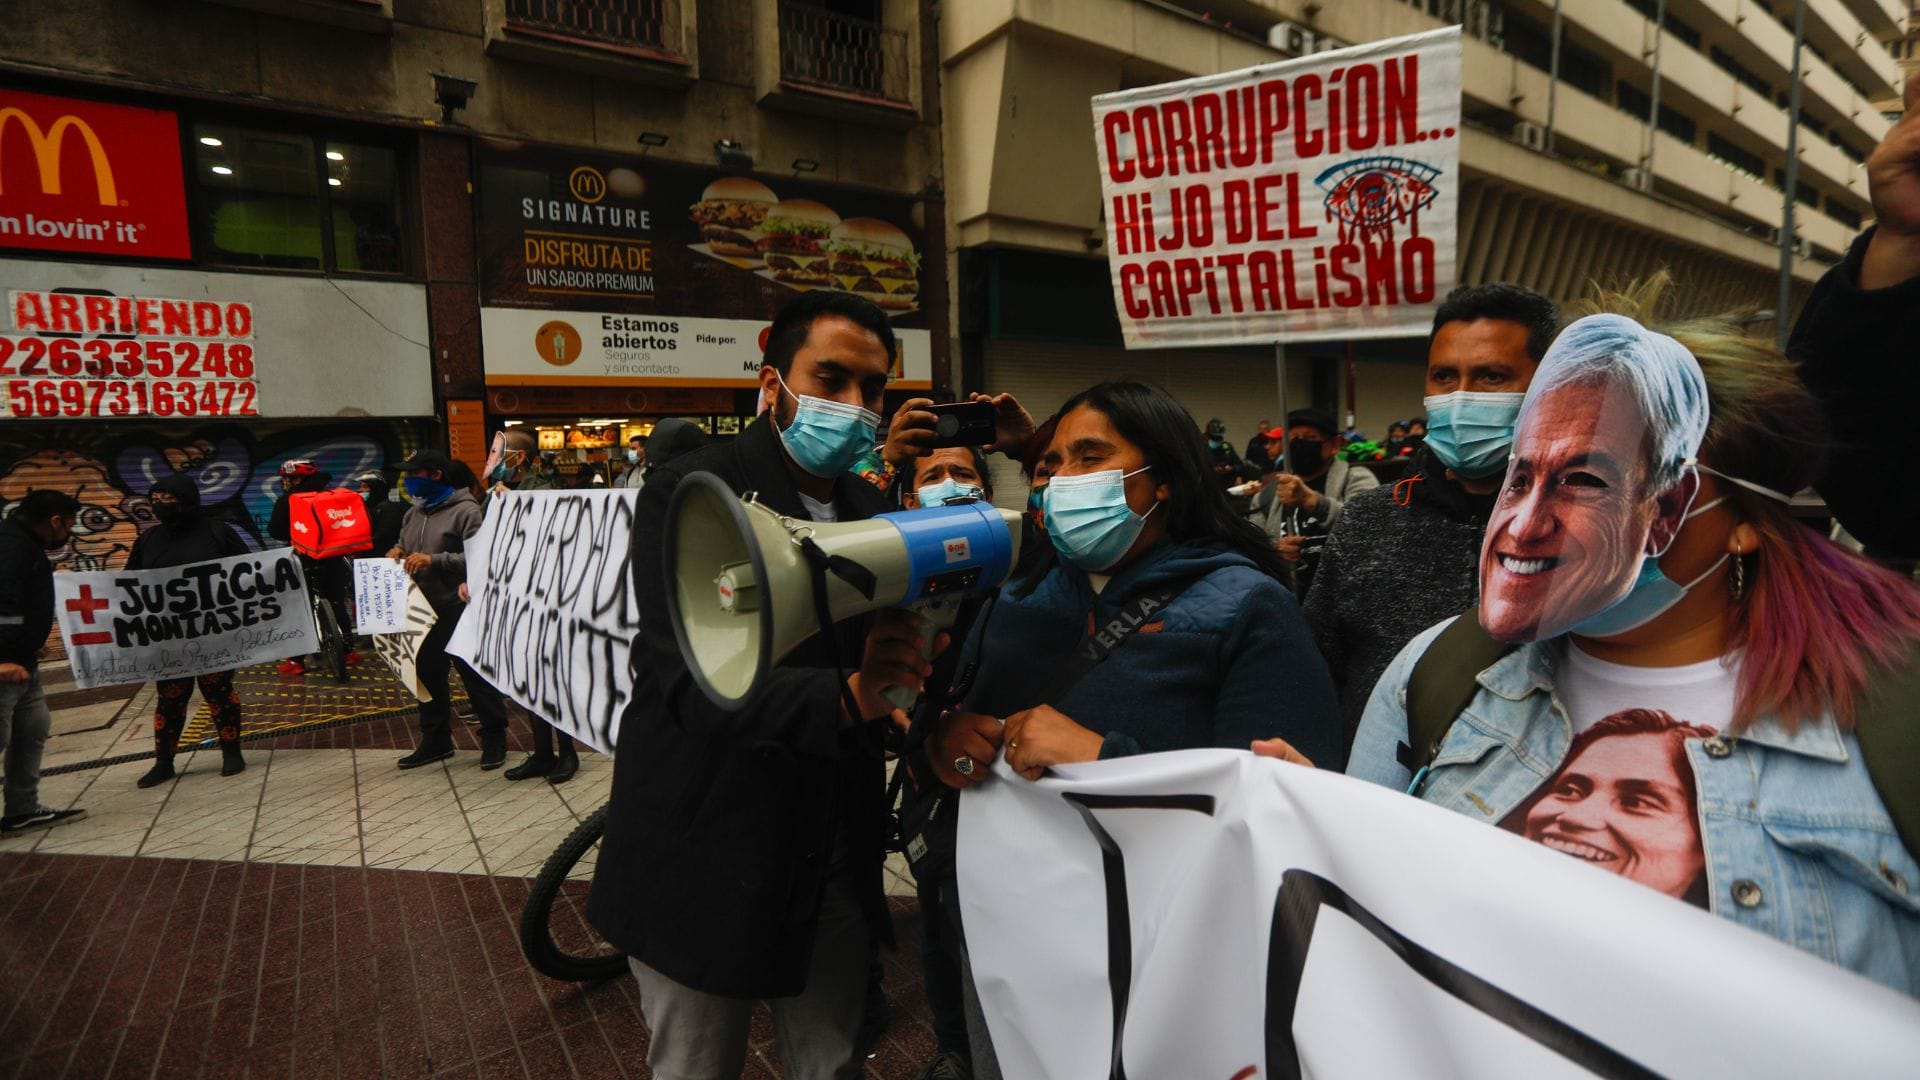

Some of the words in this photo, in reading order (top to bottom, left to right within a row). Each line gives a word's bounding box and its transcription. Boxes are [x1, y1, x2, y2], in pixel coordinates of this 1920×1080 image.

[522, 197, 651, 229] SIGNATURE
[1222, 172, 1318, 245] DEL
[25, 213, 110, 241] lovin'
[525, 238, 624, 269] DISFRUTA
[627, 246, 652, 272] DE
[526, 267, 547, 287] UN
[549, 268, 595, 289] SABOR
[596, 272, 654, 292] PREMIUM
[15, 291, 252, 338] ARRIENDO
[601, 315, 680, 334] Estamos
[602, 332, 678, 351] abiertos
[695, 334, 717, 344] Pide
[718, 336, 737, 346] por:
[604, 349, 651, 362] Seguros
[604, 364, 612, 374] y
[613, 362, 629, 374] sin
[631, 363, 680, 375] contacto
[8, 379, 257, 417] 56973163472
[487, 495, 535, 585] LOS
[113, 597, 282, 648] MONTAJES
